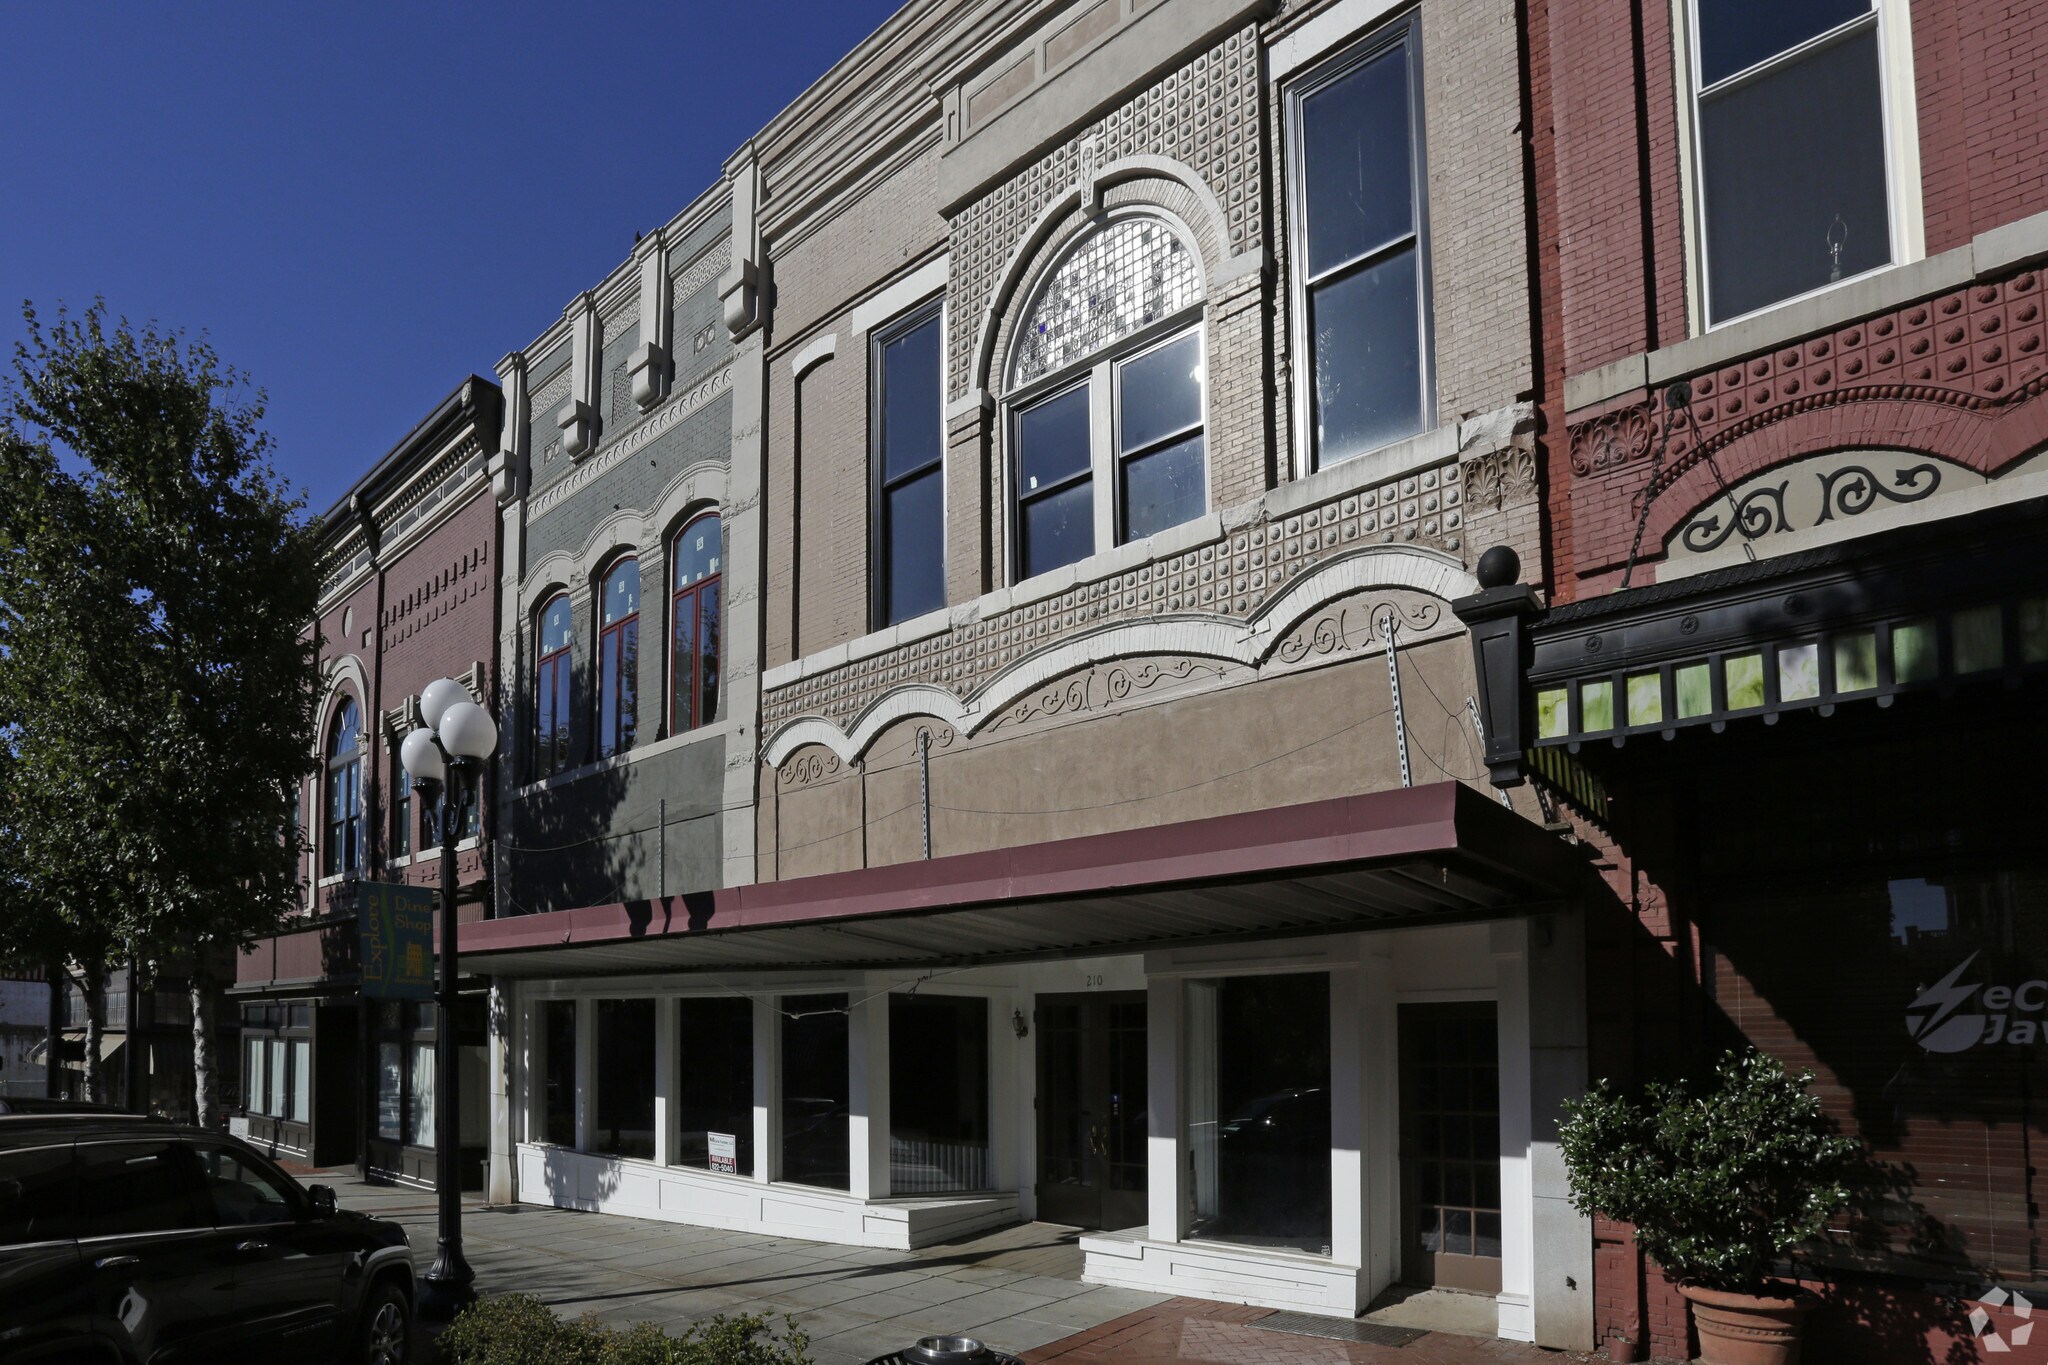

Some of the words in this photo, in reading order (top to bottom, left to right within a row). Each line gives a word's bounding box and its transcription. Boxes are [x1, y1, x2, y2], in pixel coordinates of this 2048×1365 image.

[394, 896, 431, 913] Dine
[394, 913, 432, 936] Shop
[361, 895, 388, 981] Explore
[1087, 974, 1103, 987] 210
[711, 1155, 733, 1165] AVAILABLE
